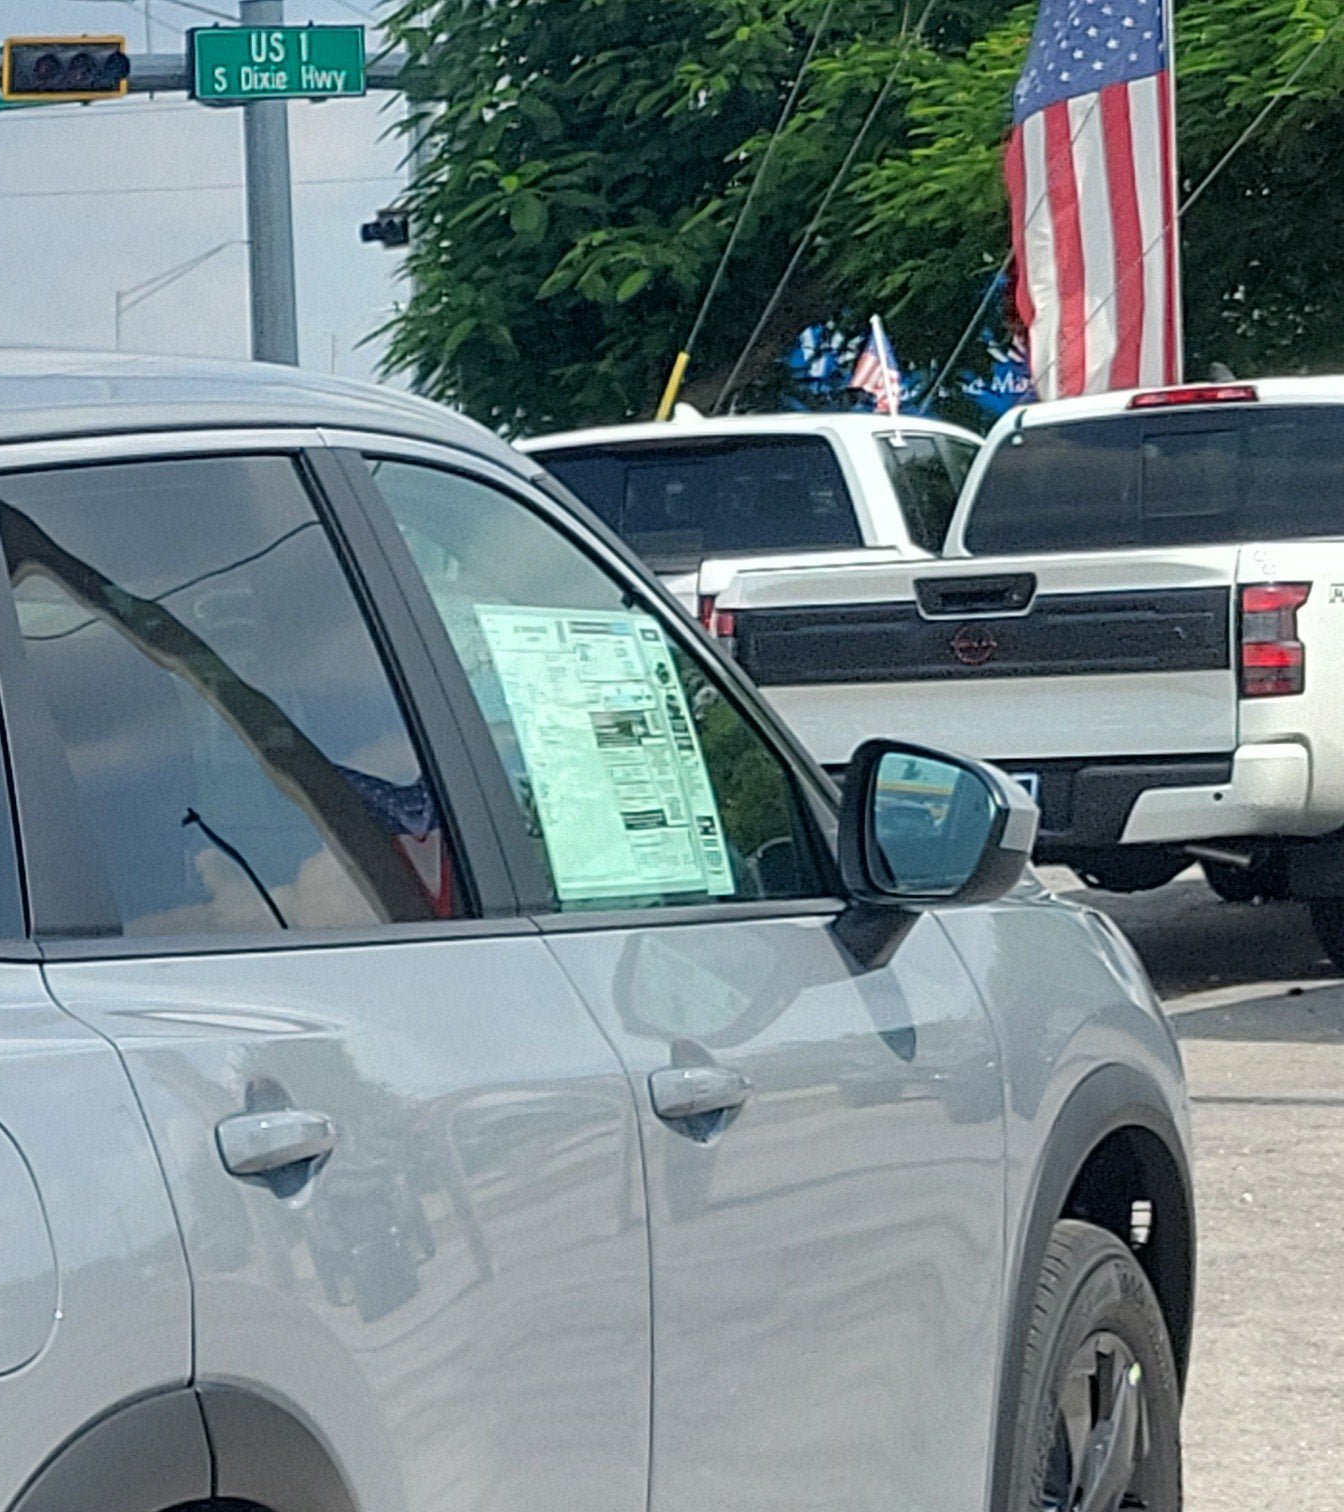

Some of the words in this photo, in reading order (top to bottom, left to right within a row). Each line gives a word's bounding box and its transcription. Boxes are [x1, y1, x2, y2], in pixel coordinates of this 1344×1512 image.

[250, 31, 285, 62] US
[300, 31, 309, 62] 1
[214, 66, 228, 92] S
[240, 65, 288, 90] Dixie
[301, 65, 348, 92] Hwy
